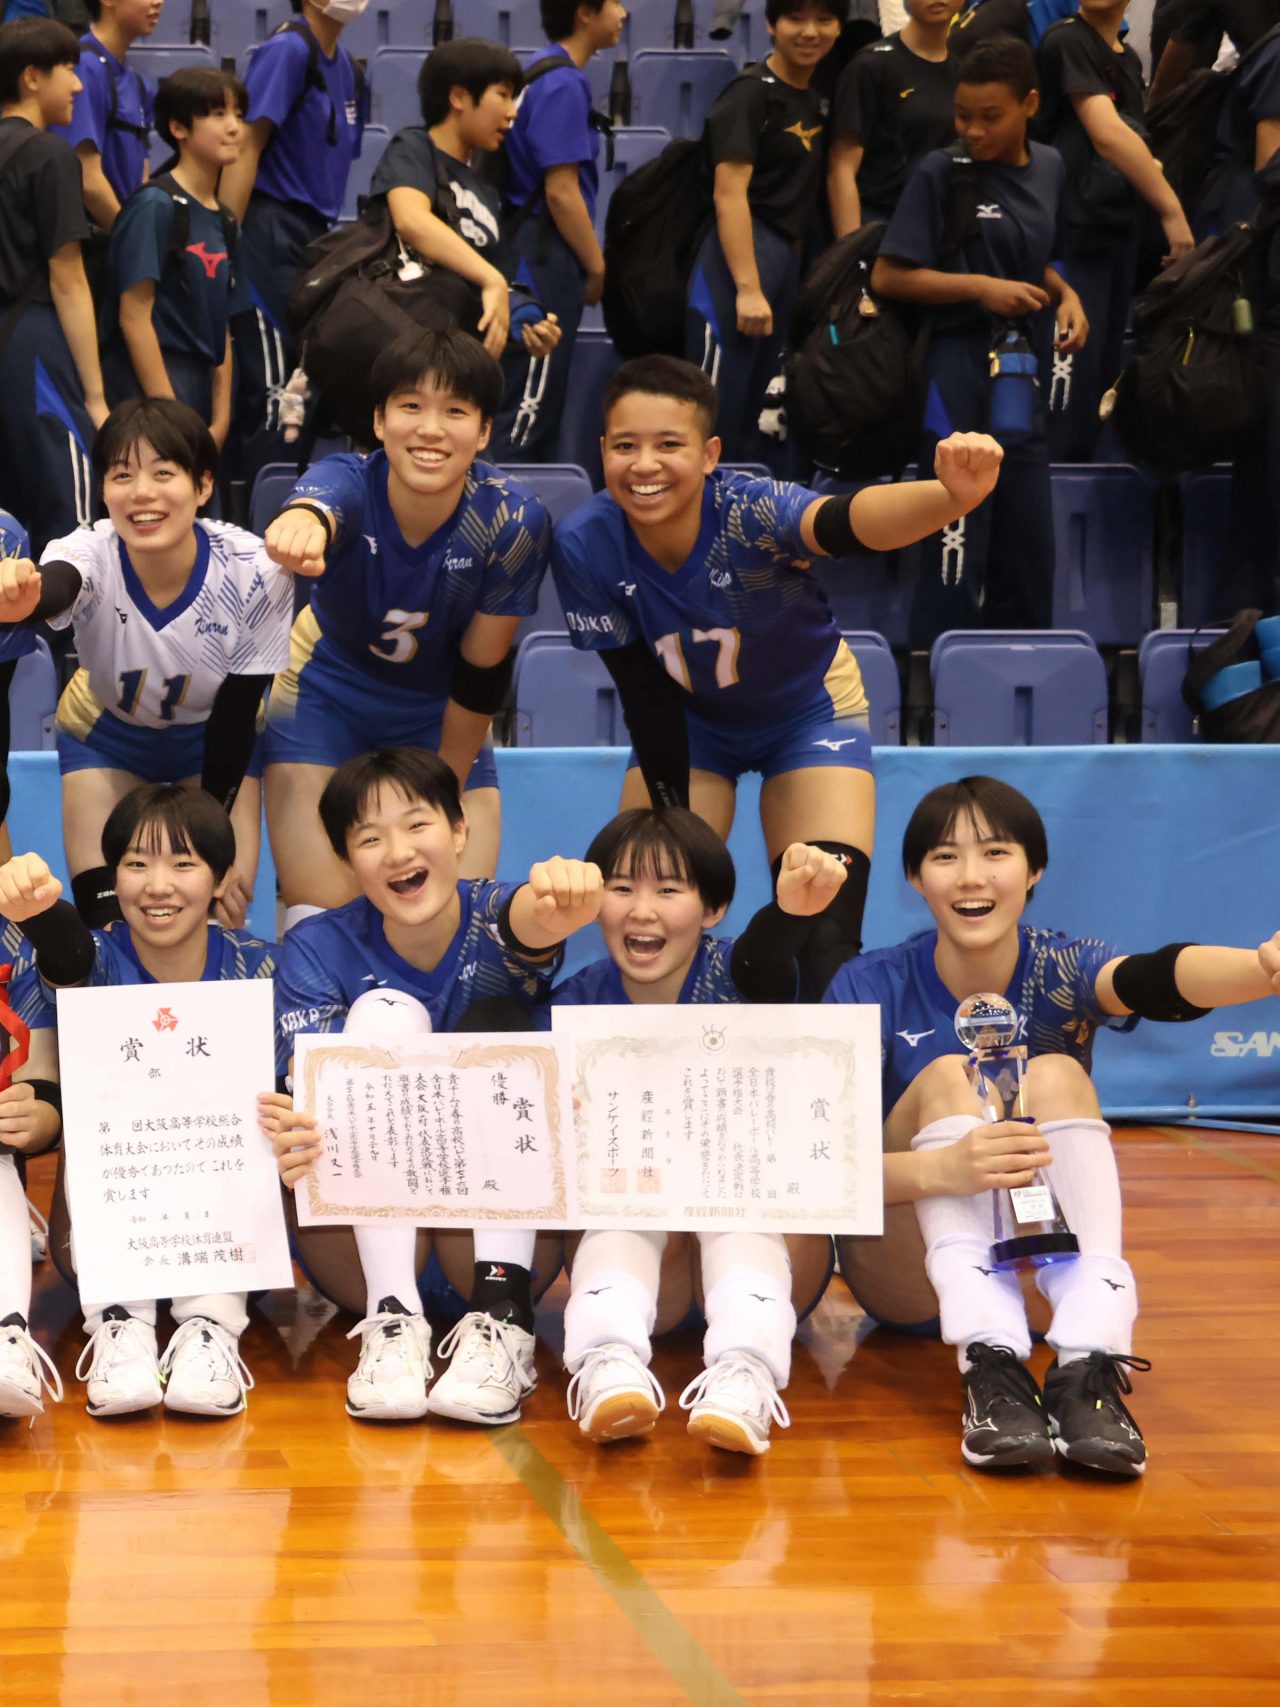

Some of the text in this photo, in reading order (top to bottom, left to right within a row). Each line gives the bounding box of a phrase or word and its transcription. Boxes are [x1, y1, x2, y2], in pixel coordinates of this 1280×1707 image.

[368, 608, 430, 664] 3
[654, 626, 741, 694] 17
[117, 668, 192, 721] 11
[120, 1035, 211, 1062] 賞状
[491, 1072, 510, 1106] 優勝
[512, 1097, 539, 1154] 賞状
[809, 1098, 831, 1160] 賞状
[482, 1179, 501, 1192] 殿
